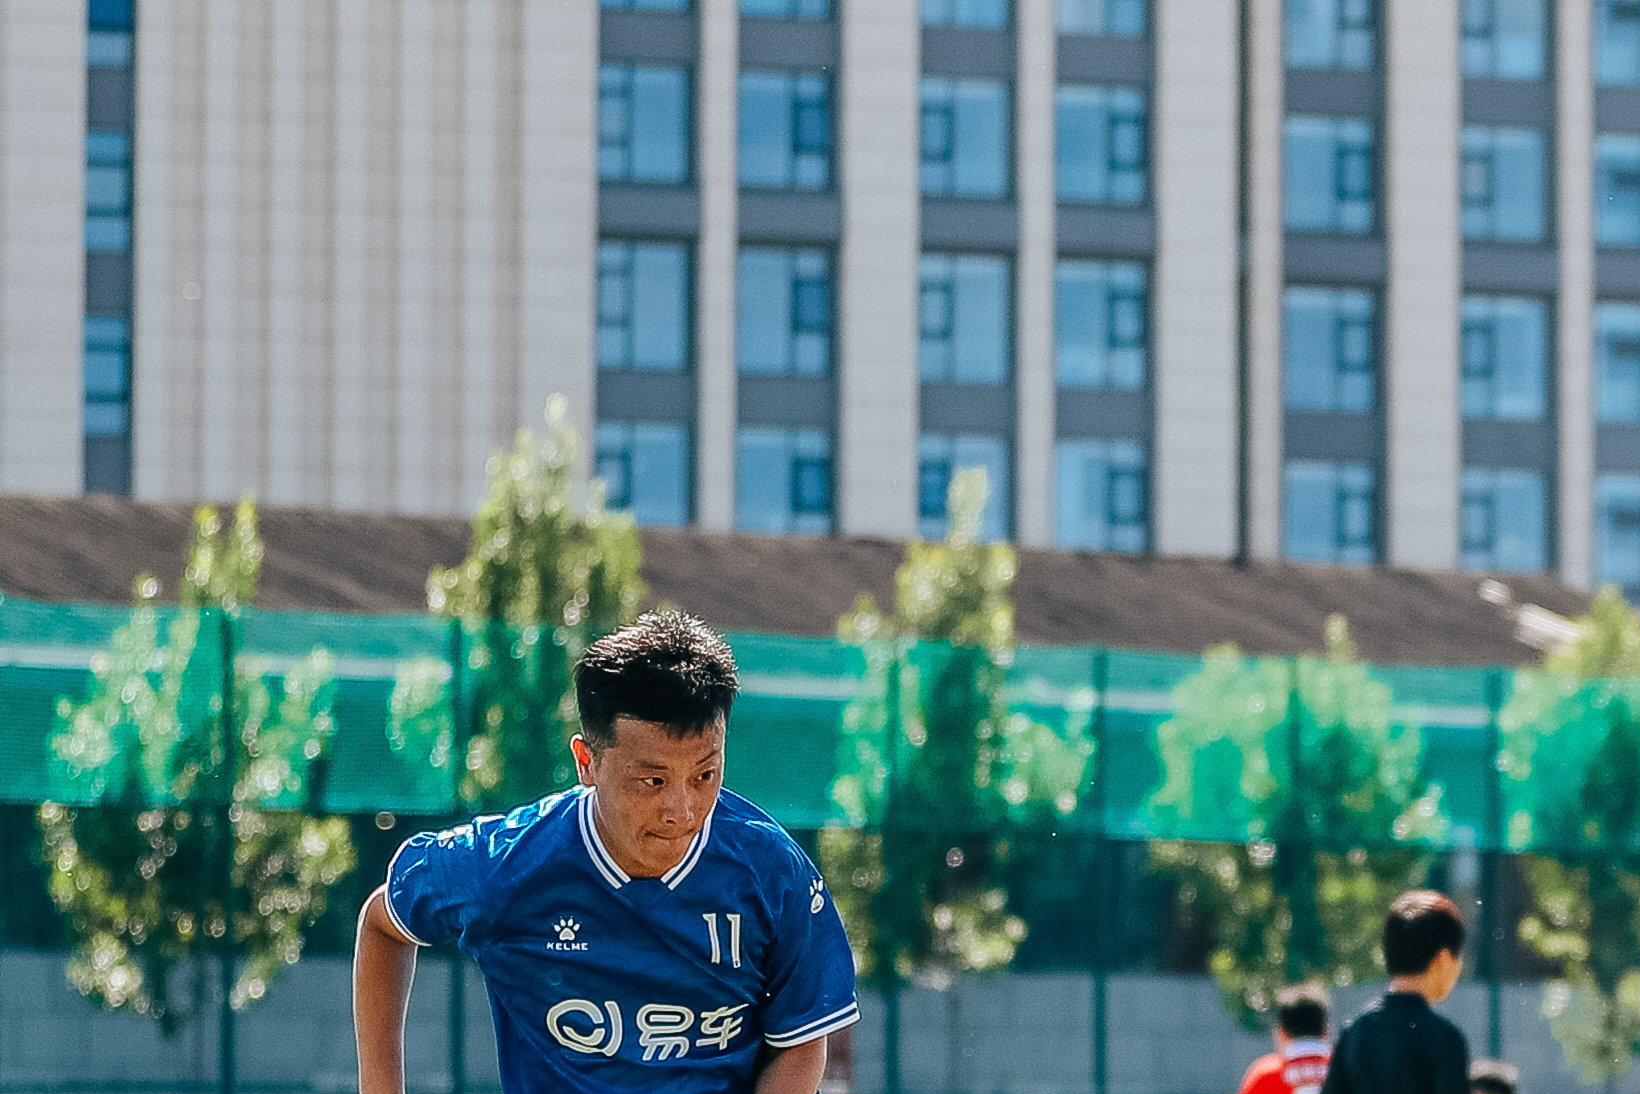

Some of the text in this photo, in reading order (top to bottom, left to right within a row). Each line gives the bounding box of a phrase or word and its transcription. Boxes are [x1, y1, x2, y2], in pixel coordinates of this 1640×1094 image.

[546, 942, 589, 951] KELME
[702, 912, 742, 969] 11
[636, 1003, 750, 1061] 易车
